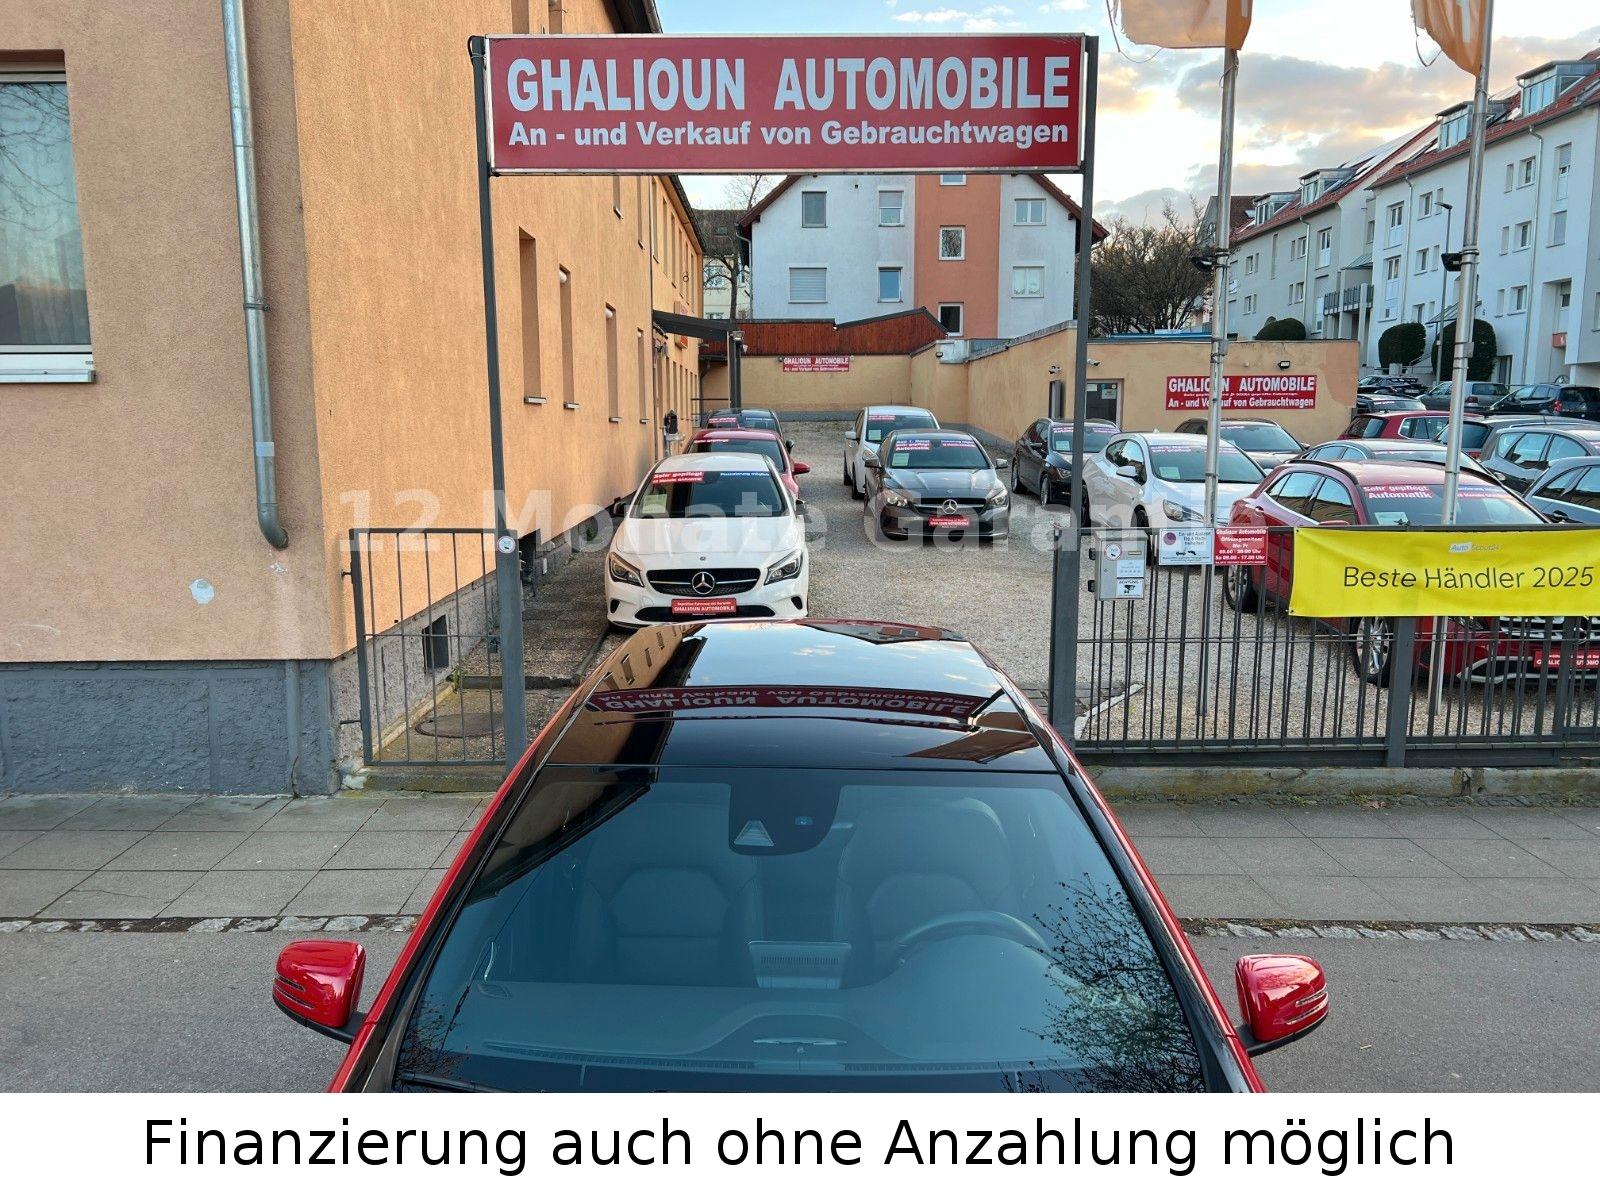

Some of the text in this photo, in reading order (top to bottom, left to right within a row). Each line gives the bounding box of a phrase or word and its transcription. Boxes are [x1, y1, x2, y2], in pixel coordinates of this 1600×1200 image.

[508, 57, 1070, 111] GHALIOUN AUTOMOBILE
[508, 122, 547, 146] An
[574, 122, 627, 146] und
[636, 121, 752, 146] Verkauf
[760, 127, 811, 145] von
[821, 120, 1068, 149] Gebrauchtwagen
[1239, 376, 1315, 392] AUTOMOBILE
[1168, 398, 1179, 408] An
[1186, 398, 1200, 408] und
[1249, 397, 1314, 409] Gebrauchtwagen
[1368, 491, 1433, 499] Automatik
[1343, 566, 1594, 589] Beste Händler 2025
